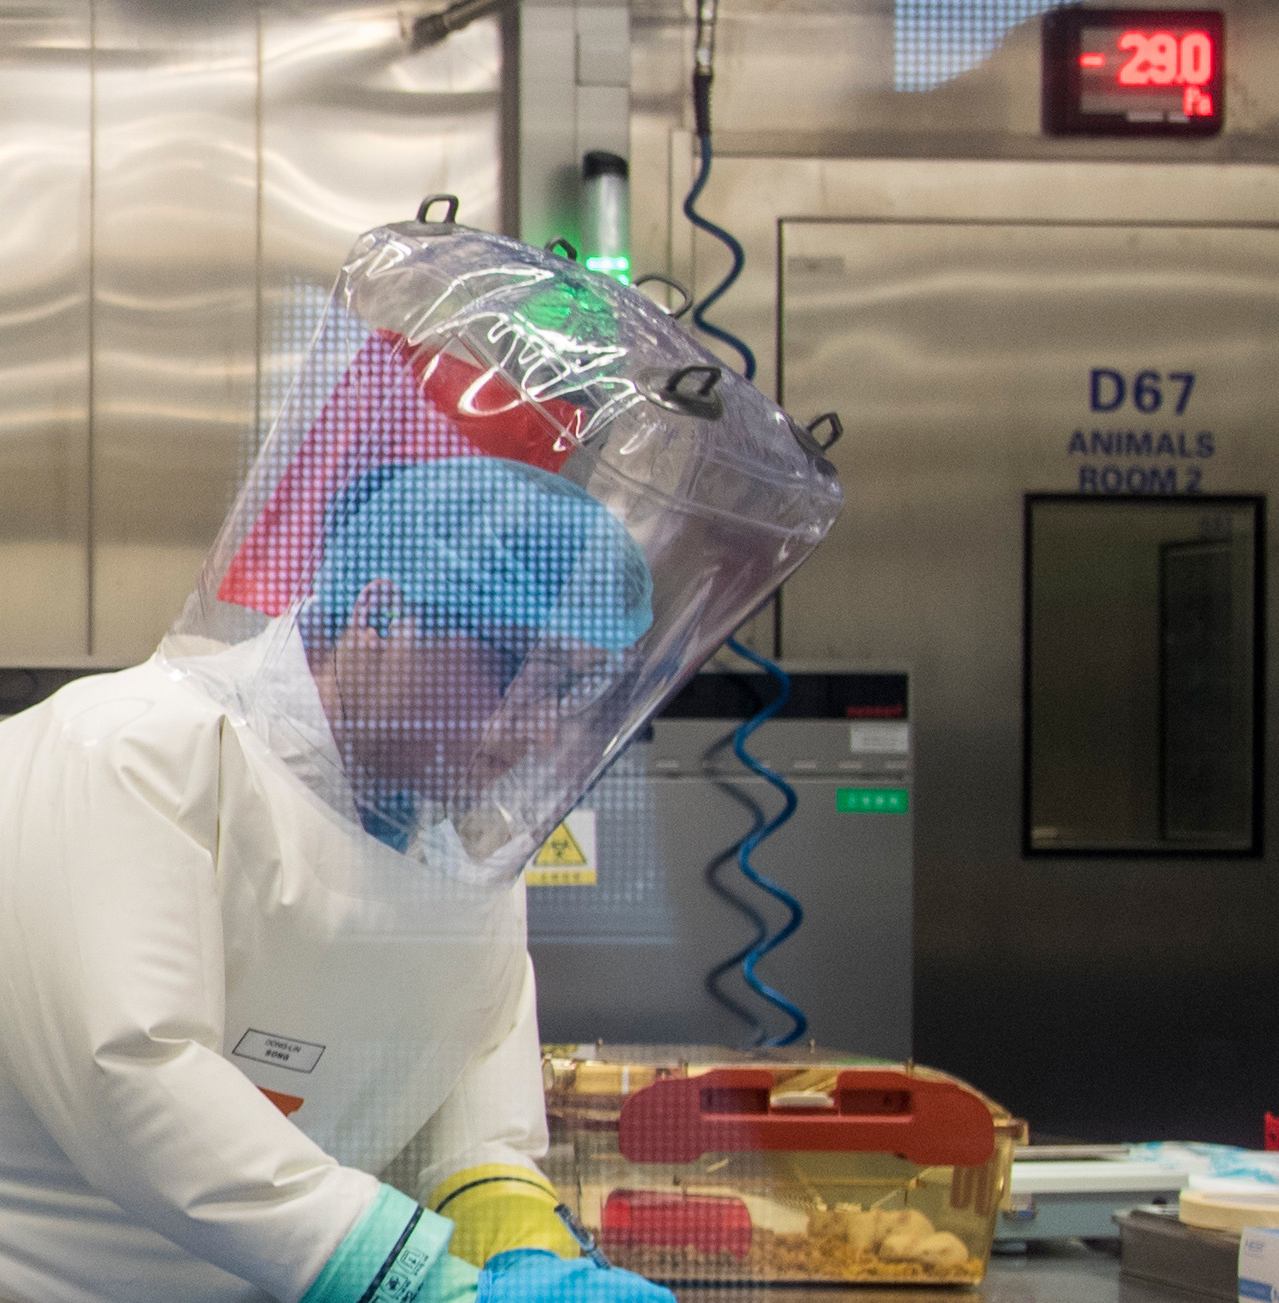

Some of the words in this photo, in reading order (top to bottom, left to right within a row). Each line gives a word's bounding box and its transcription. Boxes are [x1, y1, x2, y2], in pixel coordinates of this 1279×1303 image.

[1089, 367, 1196, 416] D67
[1068, 429, 1216, 458] ANIMALS
[1078, 464, 1178, 494] ROOM
[1185, 466, 1203, 494] 2
